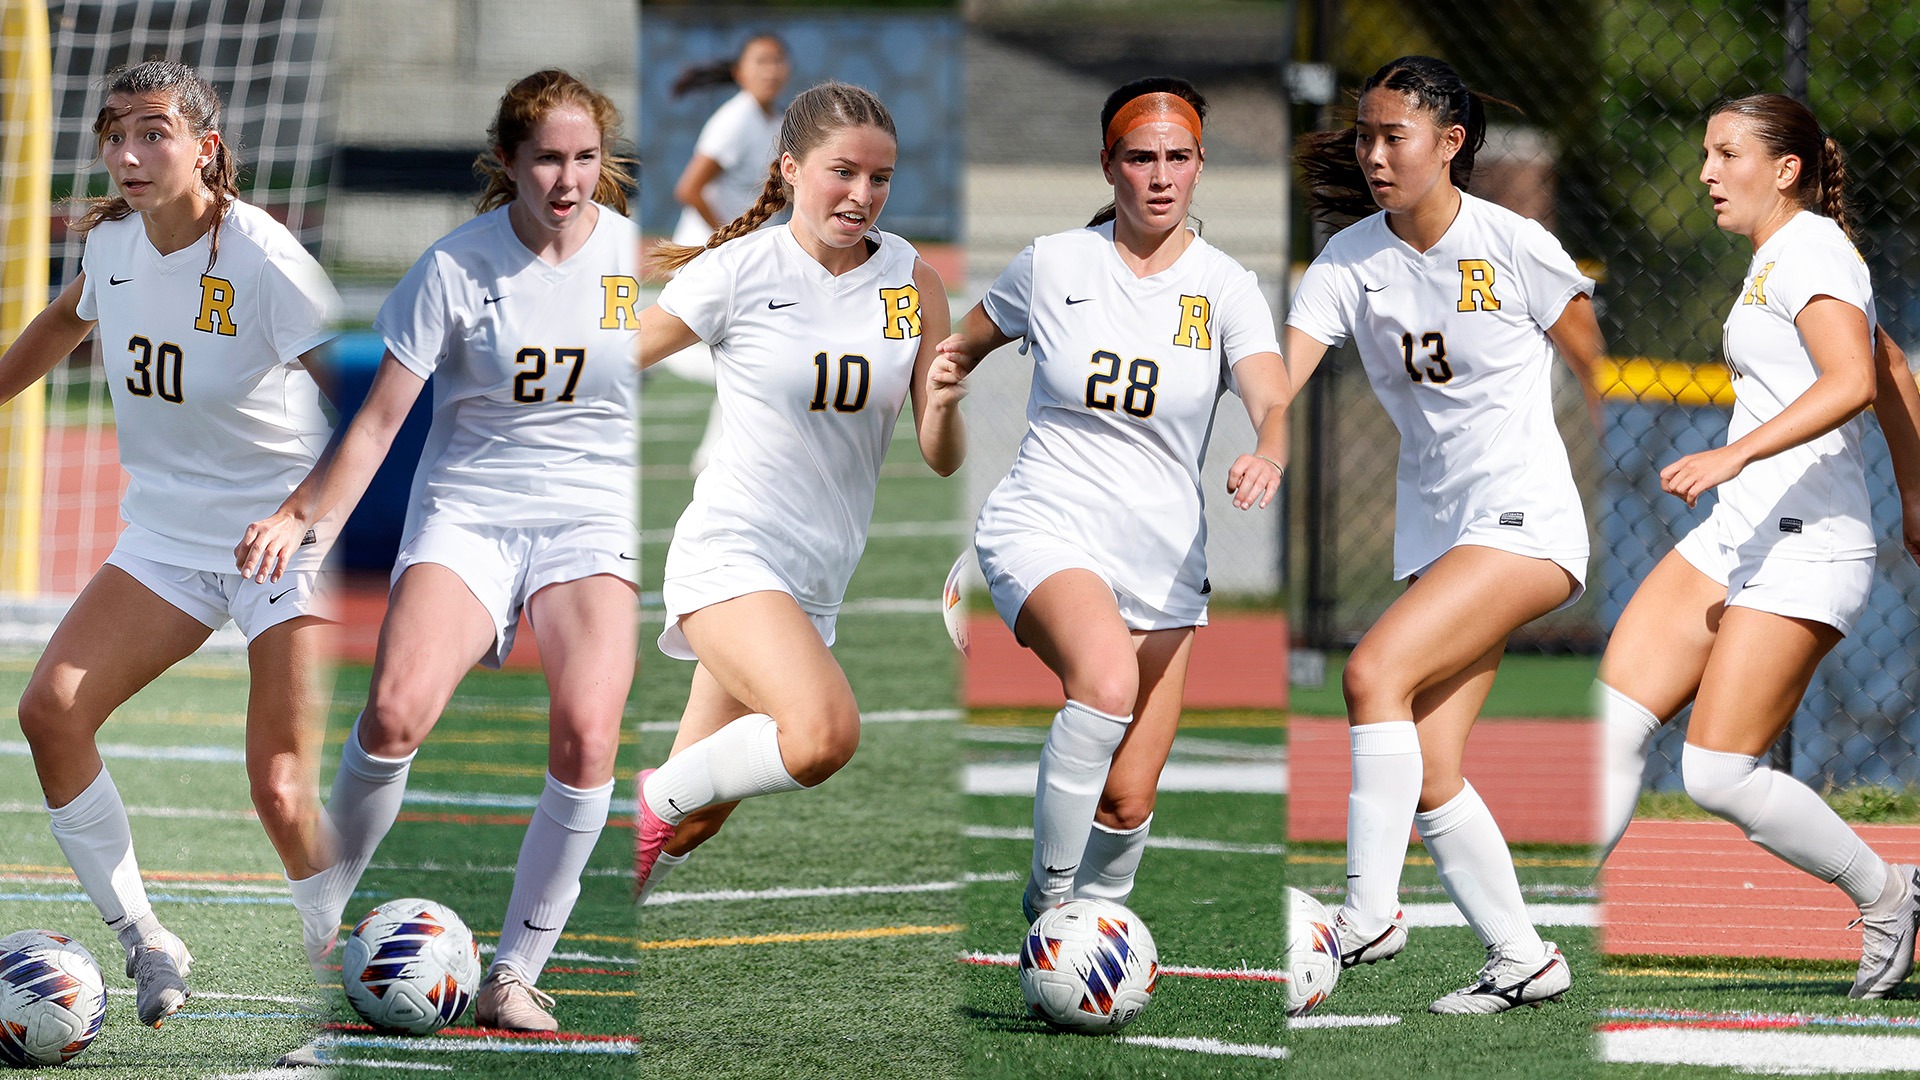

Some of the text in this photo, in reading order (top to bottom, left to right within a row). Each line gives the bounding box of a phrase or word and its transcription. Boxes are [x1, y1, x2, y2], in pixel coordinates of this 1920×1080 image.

[195, 274, 238, 336] R
[599, 275, 640, 331] R
[880, 286, 922, 340] R
[1456, 259, 1501, 313] R
[1174, 295, 1212, 351] R
[126, 336, 184, 404] 30
[513, 346, 587, 403] 27
[809, 351, 871, 413] 10
[1084, 350, 1158, 419] 28
[1401, 331, 1452, 384] 13
